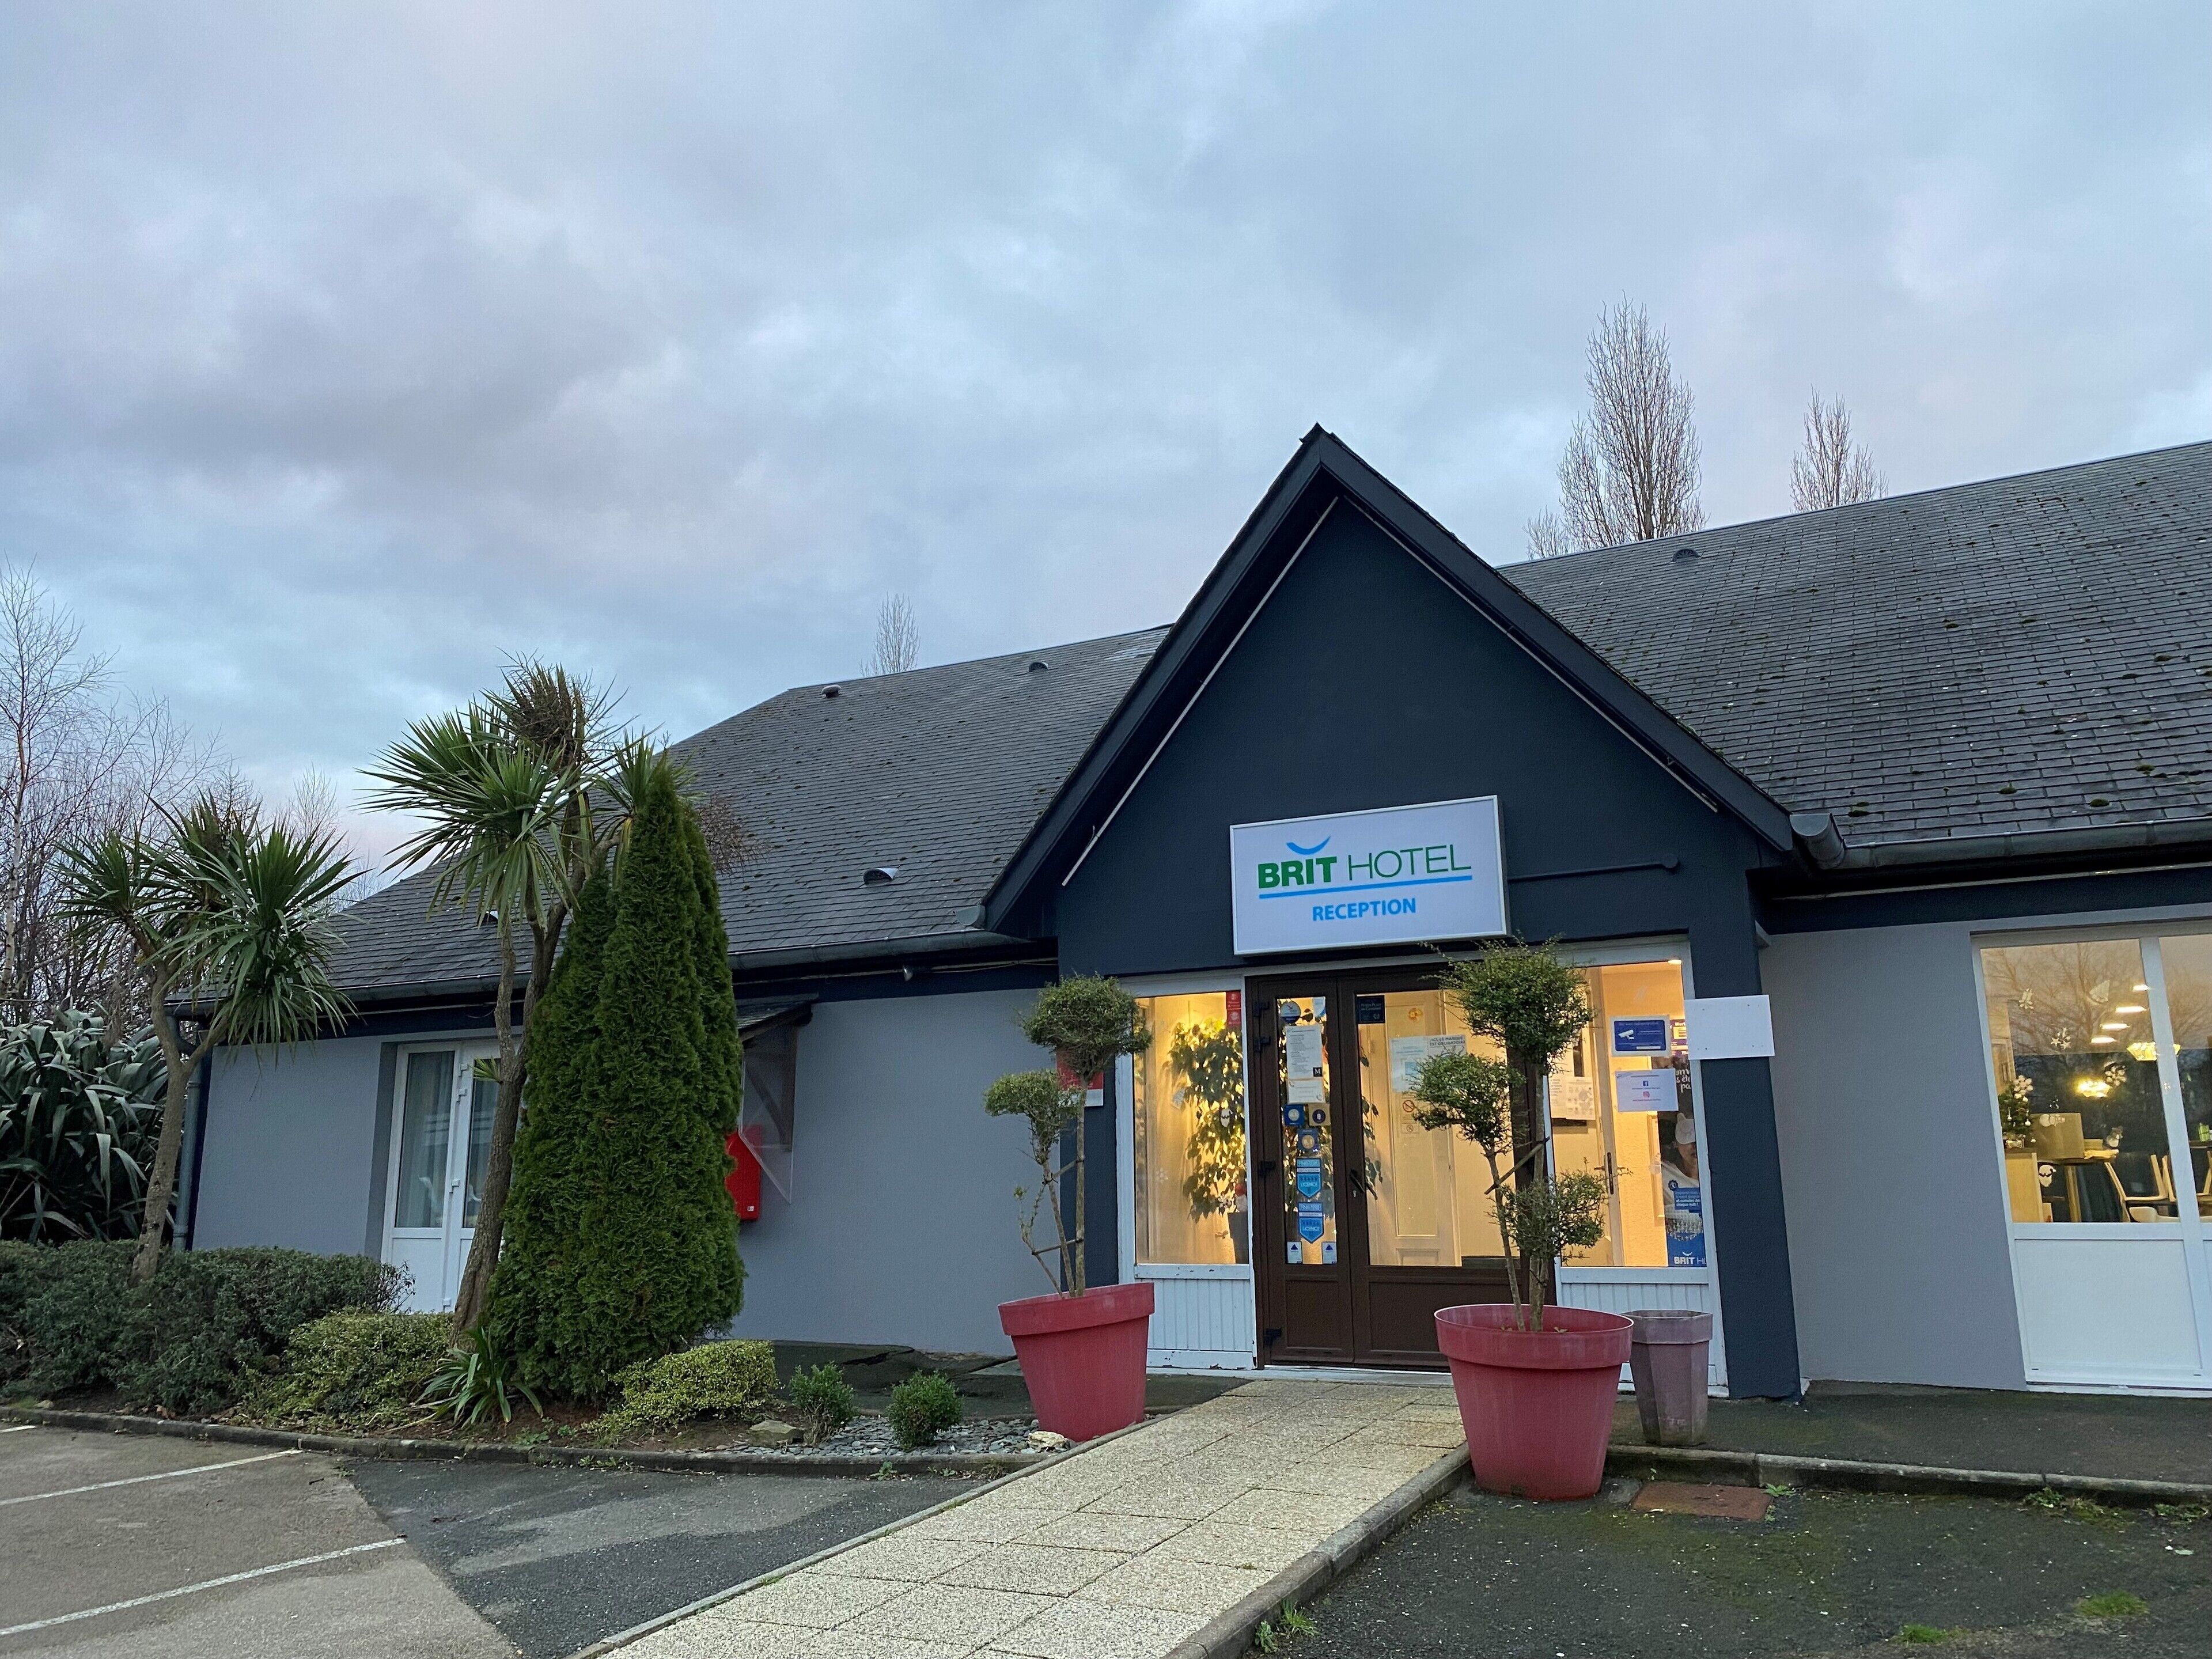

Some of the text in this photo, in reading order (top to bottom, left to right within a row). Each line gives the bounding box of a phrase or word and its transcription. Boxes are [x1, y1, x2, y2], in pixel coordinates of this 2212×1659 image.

[1257, 844, 1471, 889] BRIT HOTEL
[1312, 898, 1416, 922] RECEPTION
[1673, 1256, 1695, 1264] BRIT
